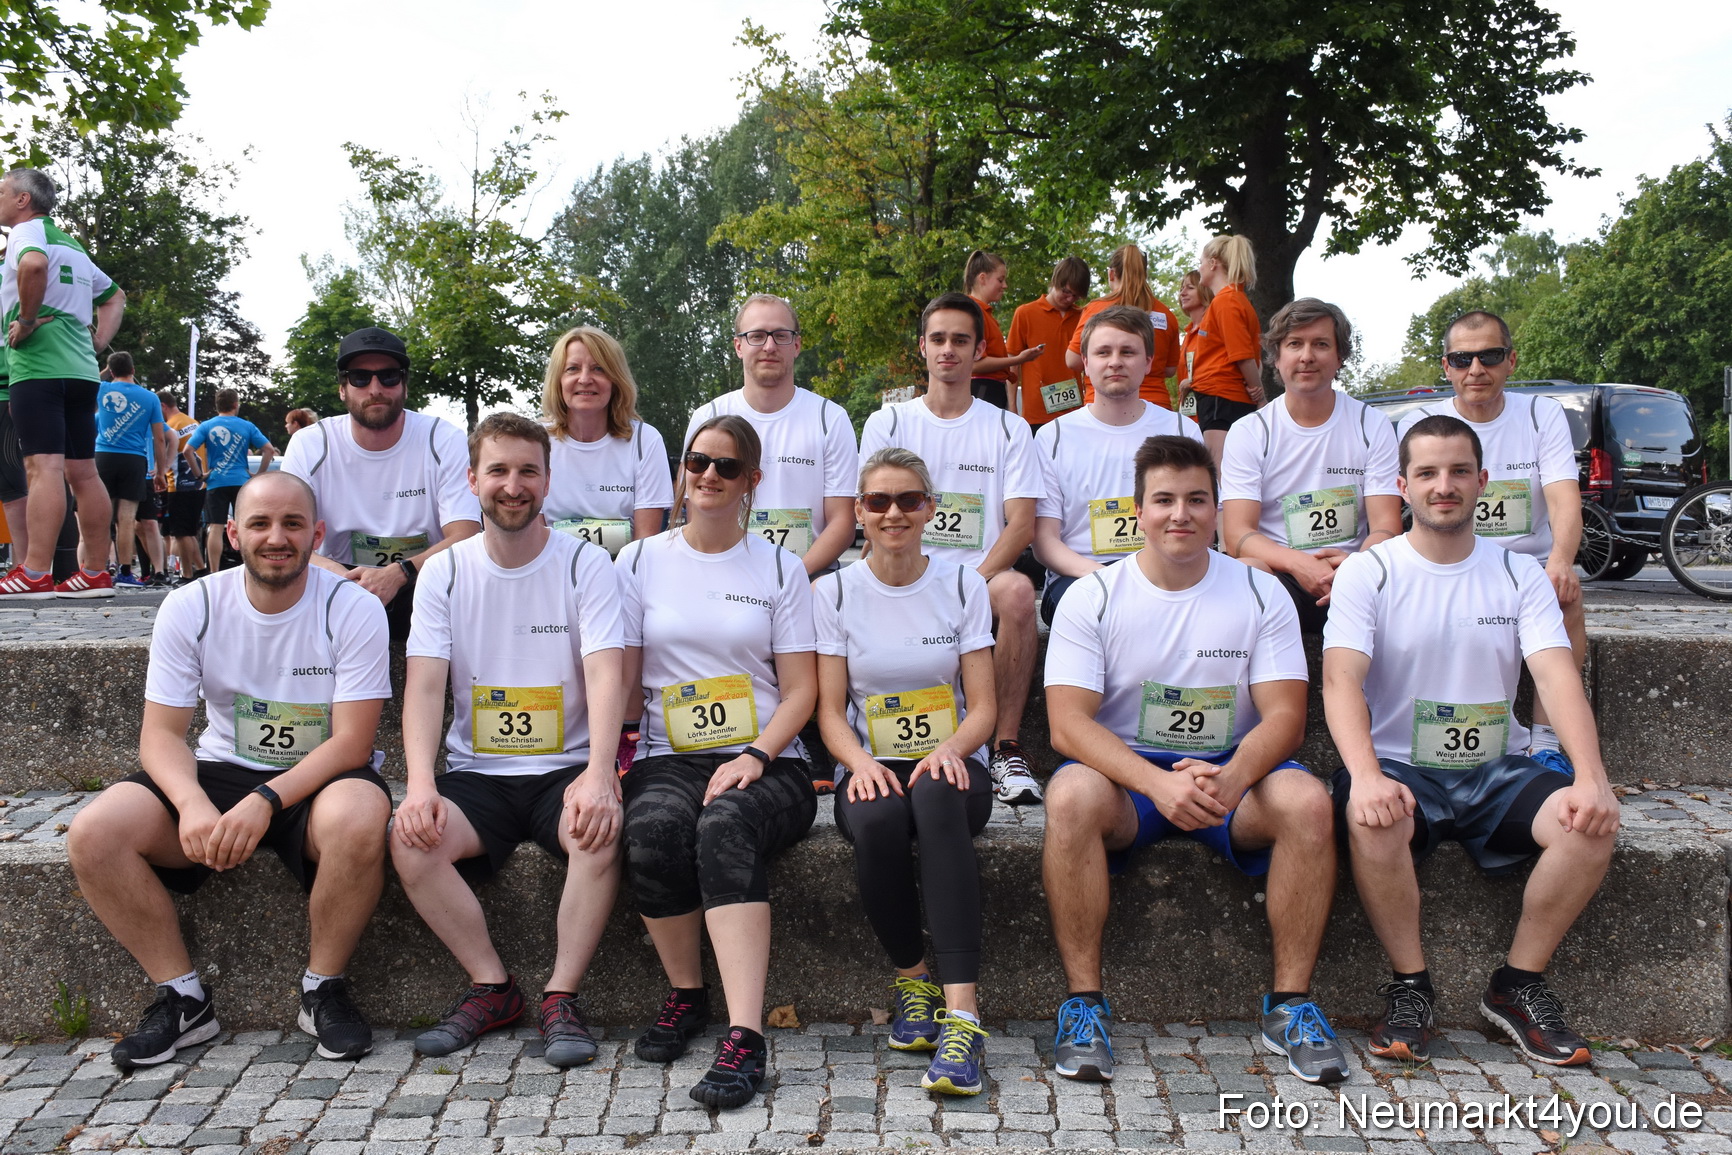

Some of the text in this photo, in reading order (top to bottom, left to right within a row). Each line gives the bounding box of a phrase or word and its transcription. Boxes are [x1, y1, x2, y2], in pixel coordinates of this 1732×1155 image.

[1048, 389, 1076, 404] 1798
[777, 456, 815, 466] auctores
[958, 463, 995, 474] auctores
[1476, 501, 1506, 522] 34
[934, 512, 962, 532] 32
[1114, 517, 1138, 537] 27
[1309, 509, 1338, 531] 28
[578, 527, 603, 545] 31
[763, 529, 790, 546] 37
[922, 530, 955, 539] Puschmann
[1326, 528, 1342, 536] Stefan
[375, 552, 404, 567] 26
[725, 593, 772, 610] auctores
[1197, 648, 1248, 658] auctores
[498, 712, 533, 736] 33
[692, 702, 727, 730] 30
[1168, 710, 1205, 733] 29
[687, 726, 737, 739] Lörks Jennifer
[896, 714, 931, 740] 35
[1155, 730, 1185, 740] Kienlein
[259, 724, 295, 749] 25
[490, 736, 509, 744] Spies
[893, 738, 939, 750] Weigl Martina
[1444, 727, 1480, 751] 36
[248, 744, 309, 756] Böhm Maximilian
[1436, 751, 1457, 759] Weigl
